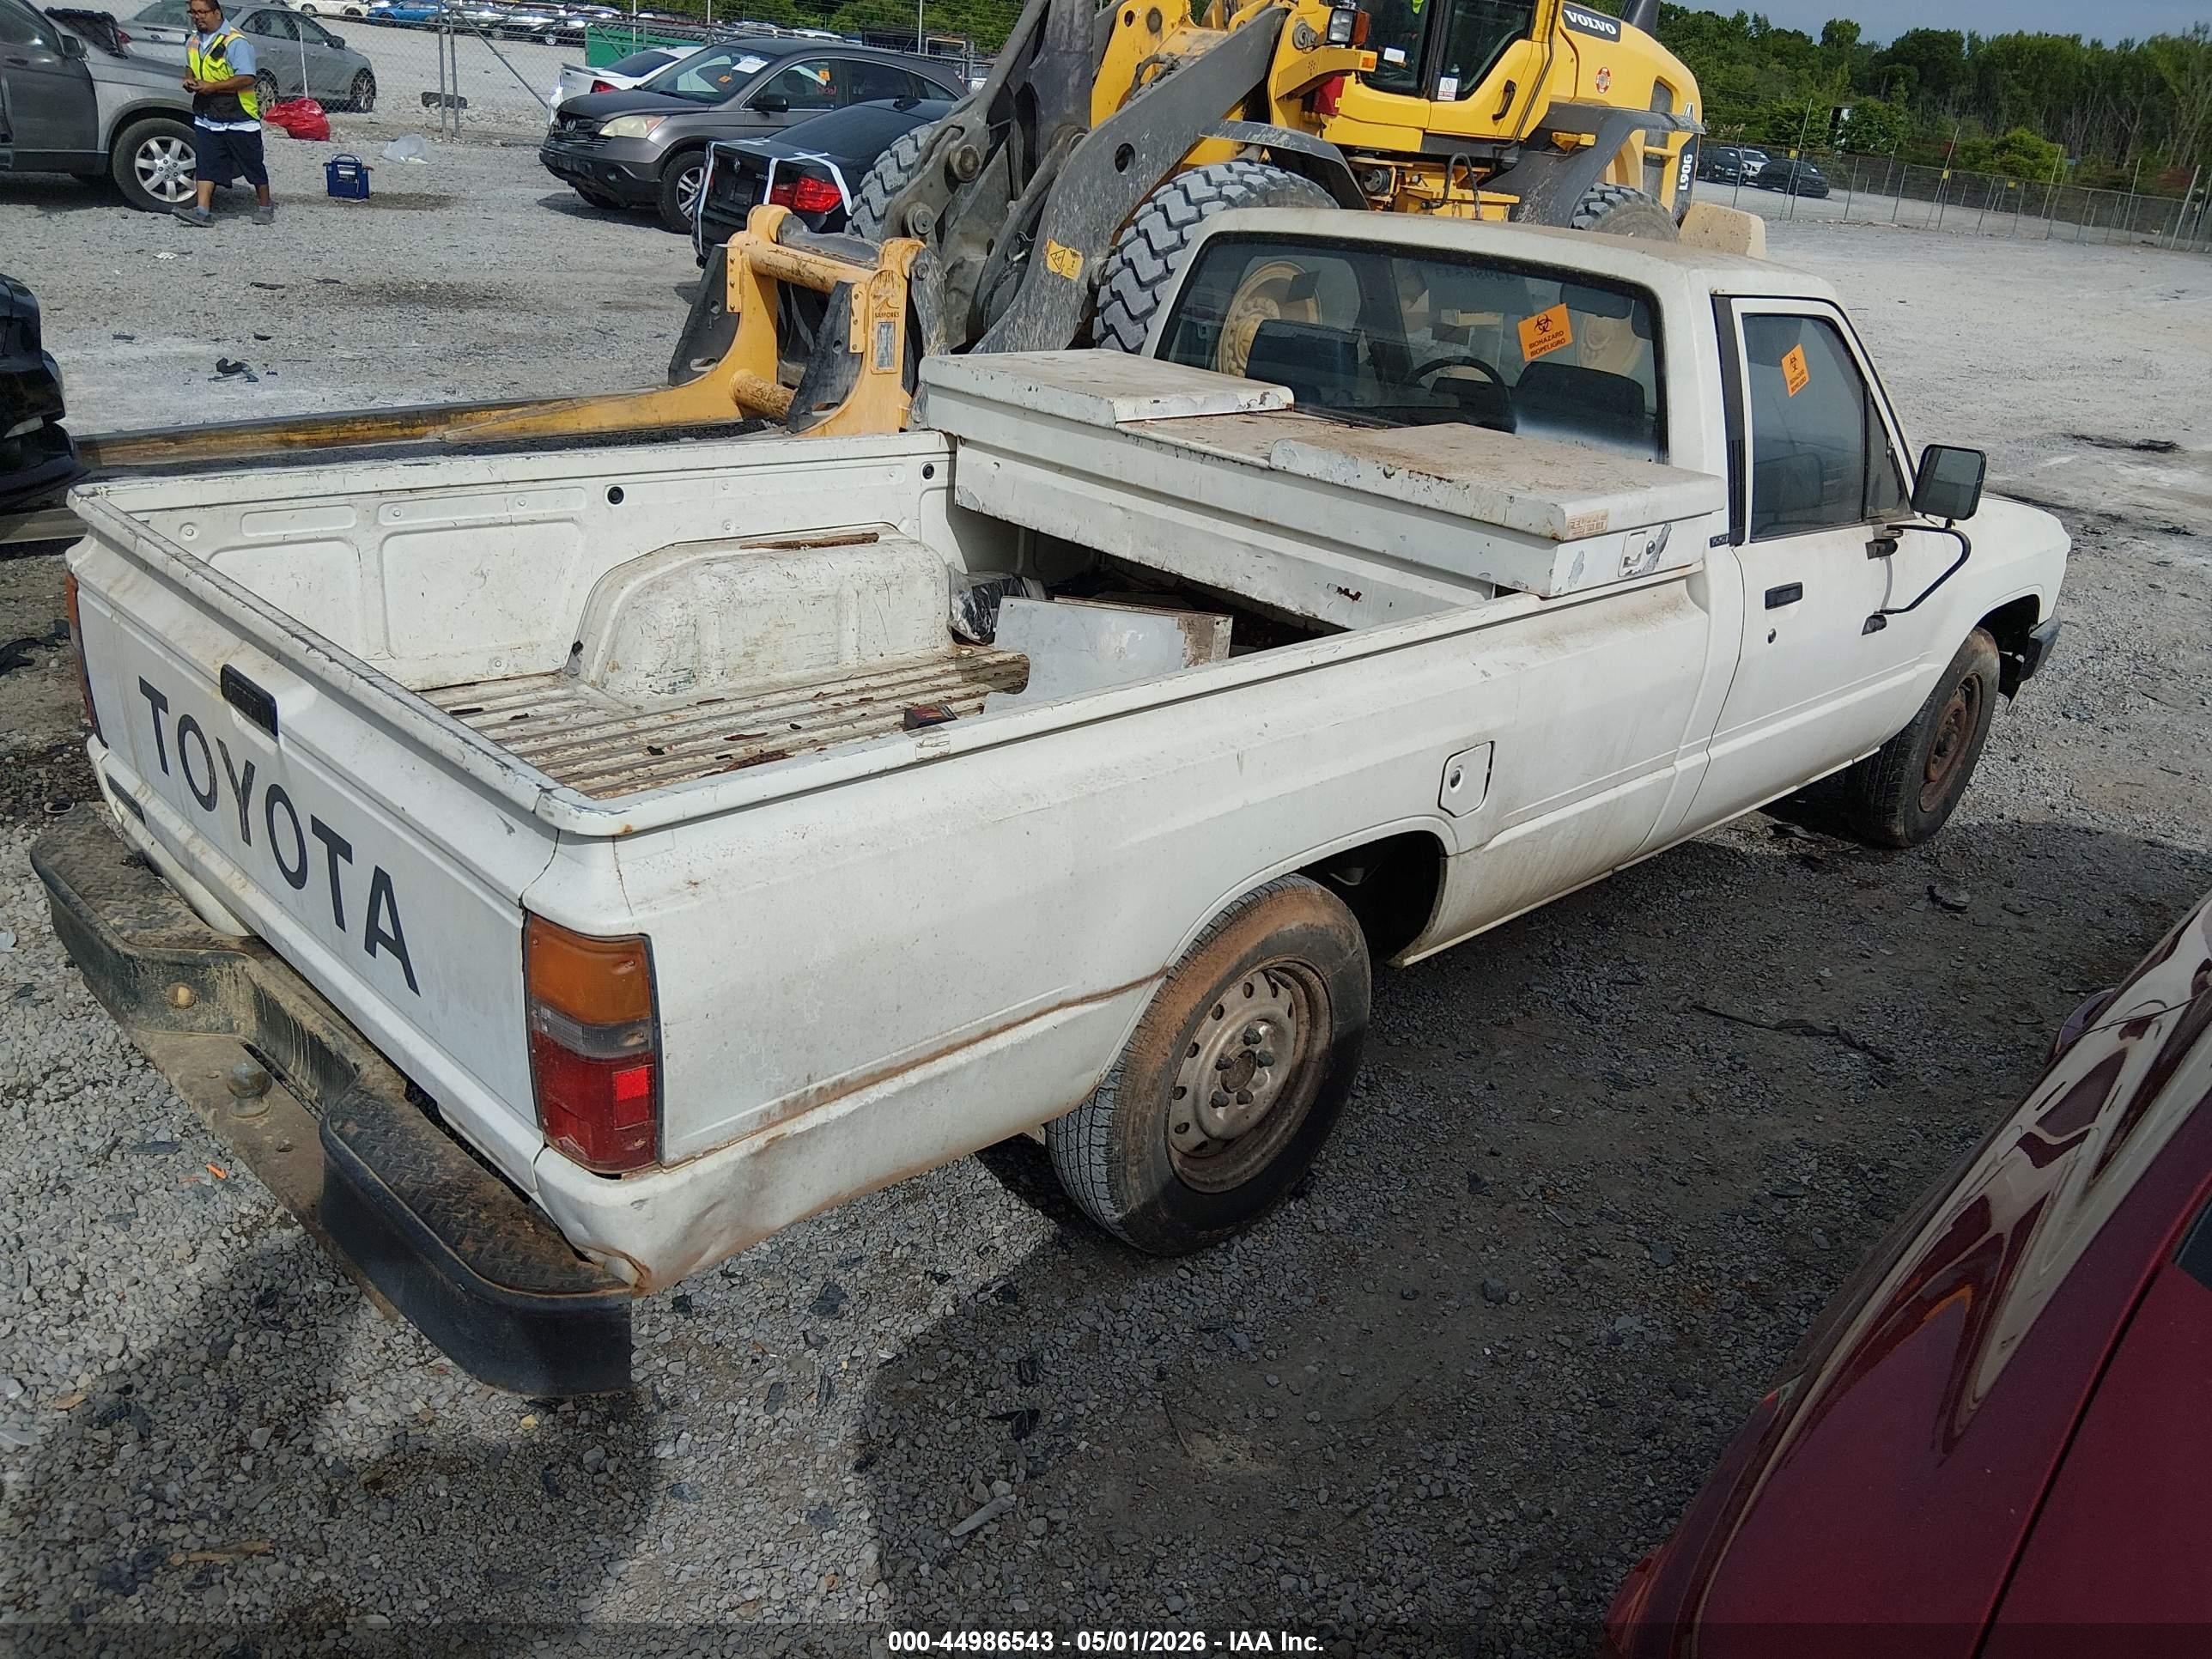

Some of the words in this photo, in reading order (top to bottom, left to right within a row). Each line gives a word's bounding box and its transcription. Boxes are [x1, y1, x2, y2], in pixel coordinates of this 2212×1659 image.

[1564, 9, 1617, 35] VOLVO
[1679, 154, 1693, 191] L90G
[1528, 331, 1565, 349] BIOHAZARD
[1530, 337, 1565, 357] BIOPELIGRO
[138, 675, 422, 998] TOYOTA
